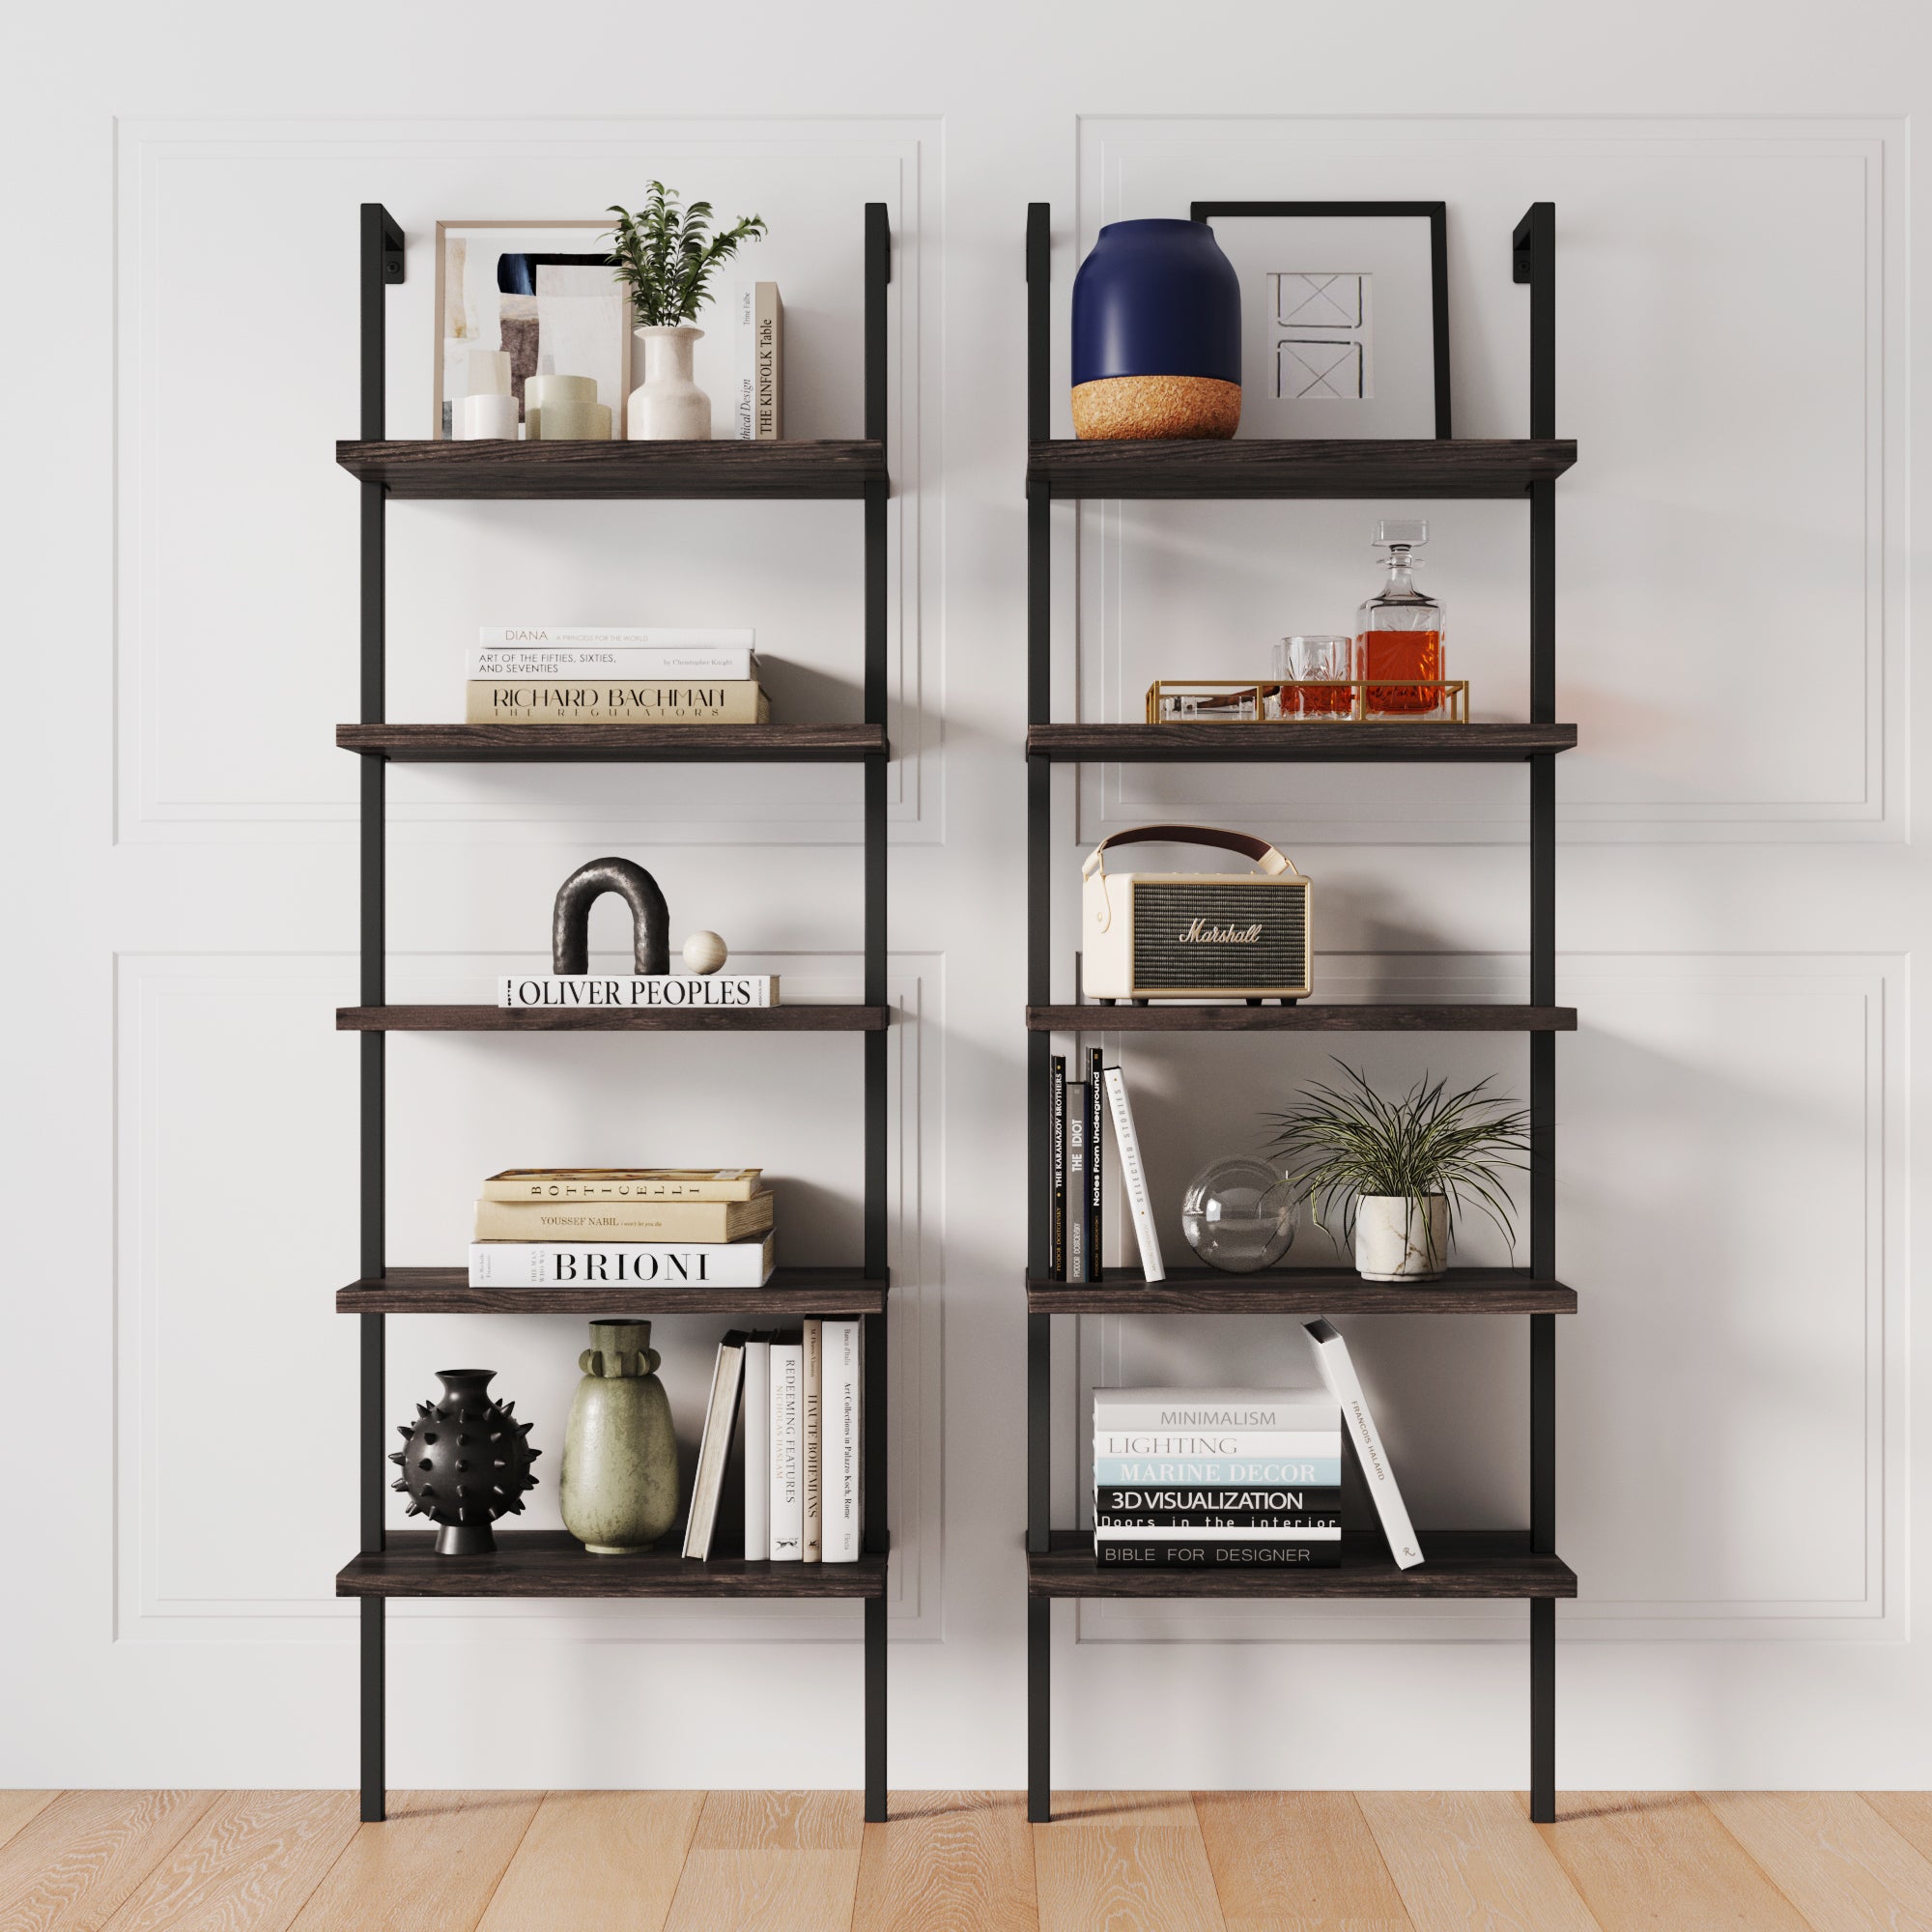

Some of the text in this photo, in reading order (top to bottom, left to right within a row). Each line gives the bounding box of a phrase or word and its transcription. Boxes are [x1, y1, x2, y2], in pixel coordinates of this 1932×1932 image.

[760, 319, 772, 435] THE KINFOLK Table
[740, 380, 753, 440] thical Design
[505, 630, 549, 640] DIANA
[479, 654, 616, 664] ART OF THE FIFTIES, SIXTIES,
[494, 689, 724, 707] RICHARD BACHMAN
[1179, 918, 1263, 943] Marshall
[519, 980, 622, 1005] OLIVER
[631, 980, 751, 1005] PEOPLES
[1072, 1119, 1082, 1172] THE IDIOT
[1115, 1090, 1144, 1203] SELECTED STORIES
[531, 1185, 699, 1196] BOTTICELLI
[541, 1217, 619, 1226] YOUSSEF NABIL
[553, 1253, 710, 1281] BRIONI
[1160, 1411, 1276, 1426] MINIMALISM
[785, 1359, 795, 1504] REDEEMING FEATURES
[1350, 1401, 1385, 1481] FRANCOIS HALARD
[1109, 1437, 1237, 1455] LIGHTING
[808, 1395, 817, 1519] HAUTE BOHEMIANS
[1120, 1463, 1316, 1482] MARINE DECOR
[1111, 1492, 1303, 1510] 3D VISUALIZATION
[1101, 1516, 1336, 1528] Doors in the interior
[1105, 1548, 1311, 1561] BIBLE FOR DESIGNER
